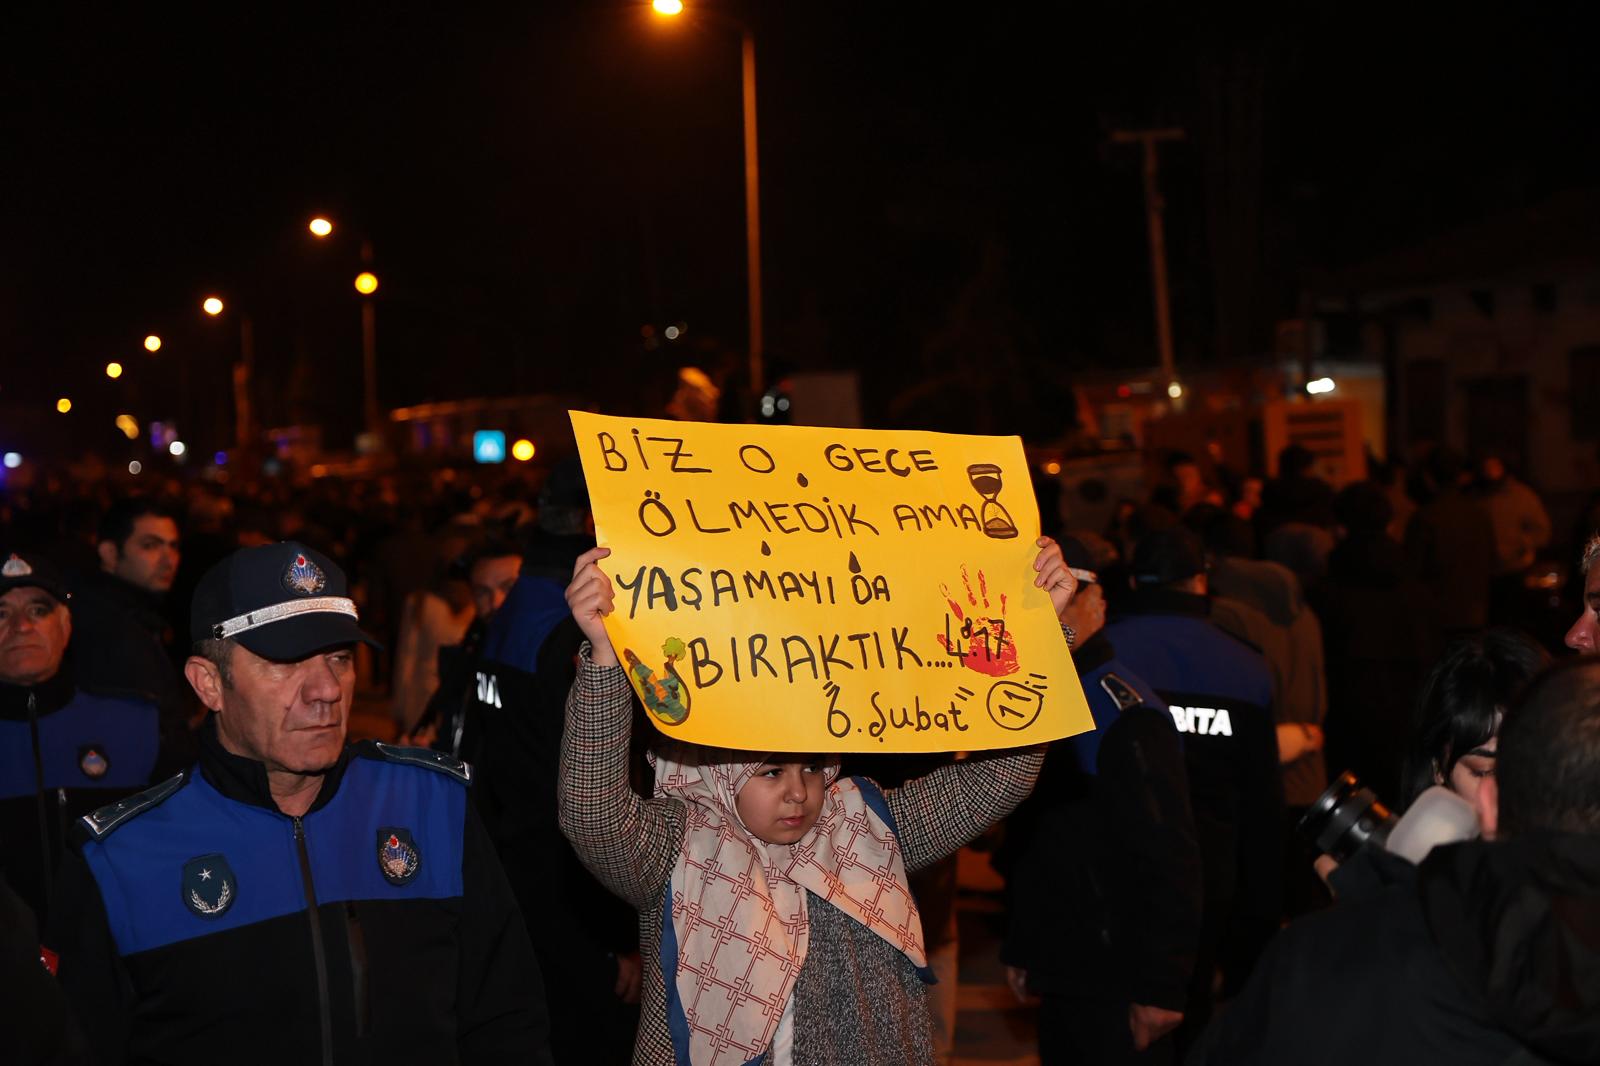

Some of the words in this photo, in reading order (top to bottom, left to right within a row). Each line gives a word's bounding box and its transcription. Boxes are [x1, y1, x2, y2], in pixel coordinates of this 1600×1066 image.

[597, 428, 713, 473] BİZ
[739, 444, 776, 474] O
[824, 443, 938, 477] GECE
[638, 489, 880, 539] ÖLMEDİK
[893, 504, 982, 532] AMA
[615, 565, 836, 619] YAŞAMAYI
[851, 574, 891, 605] DA
